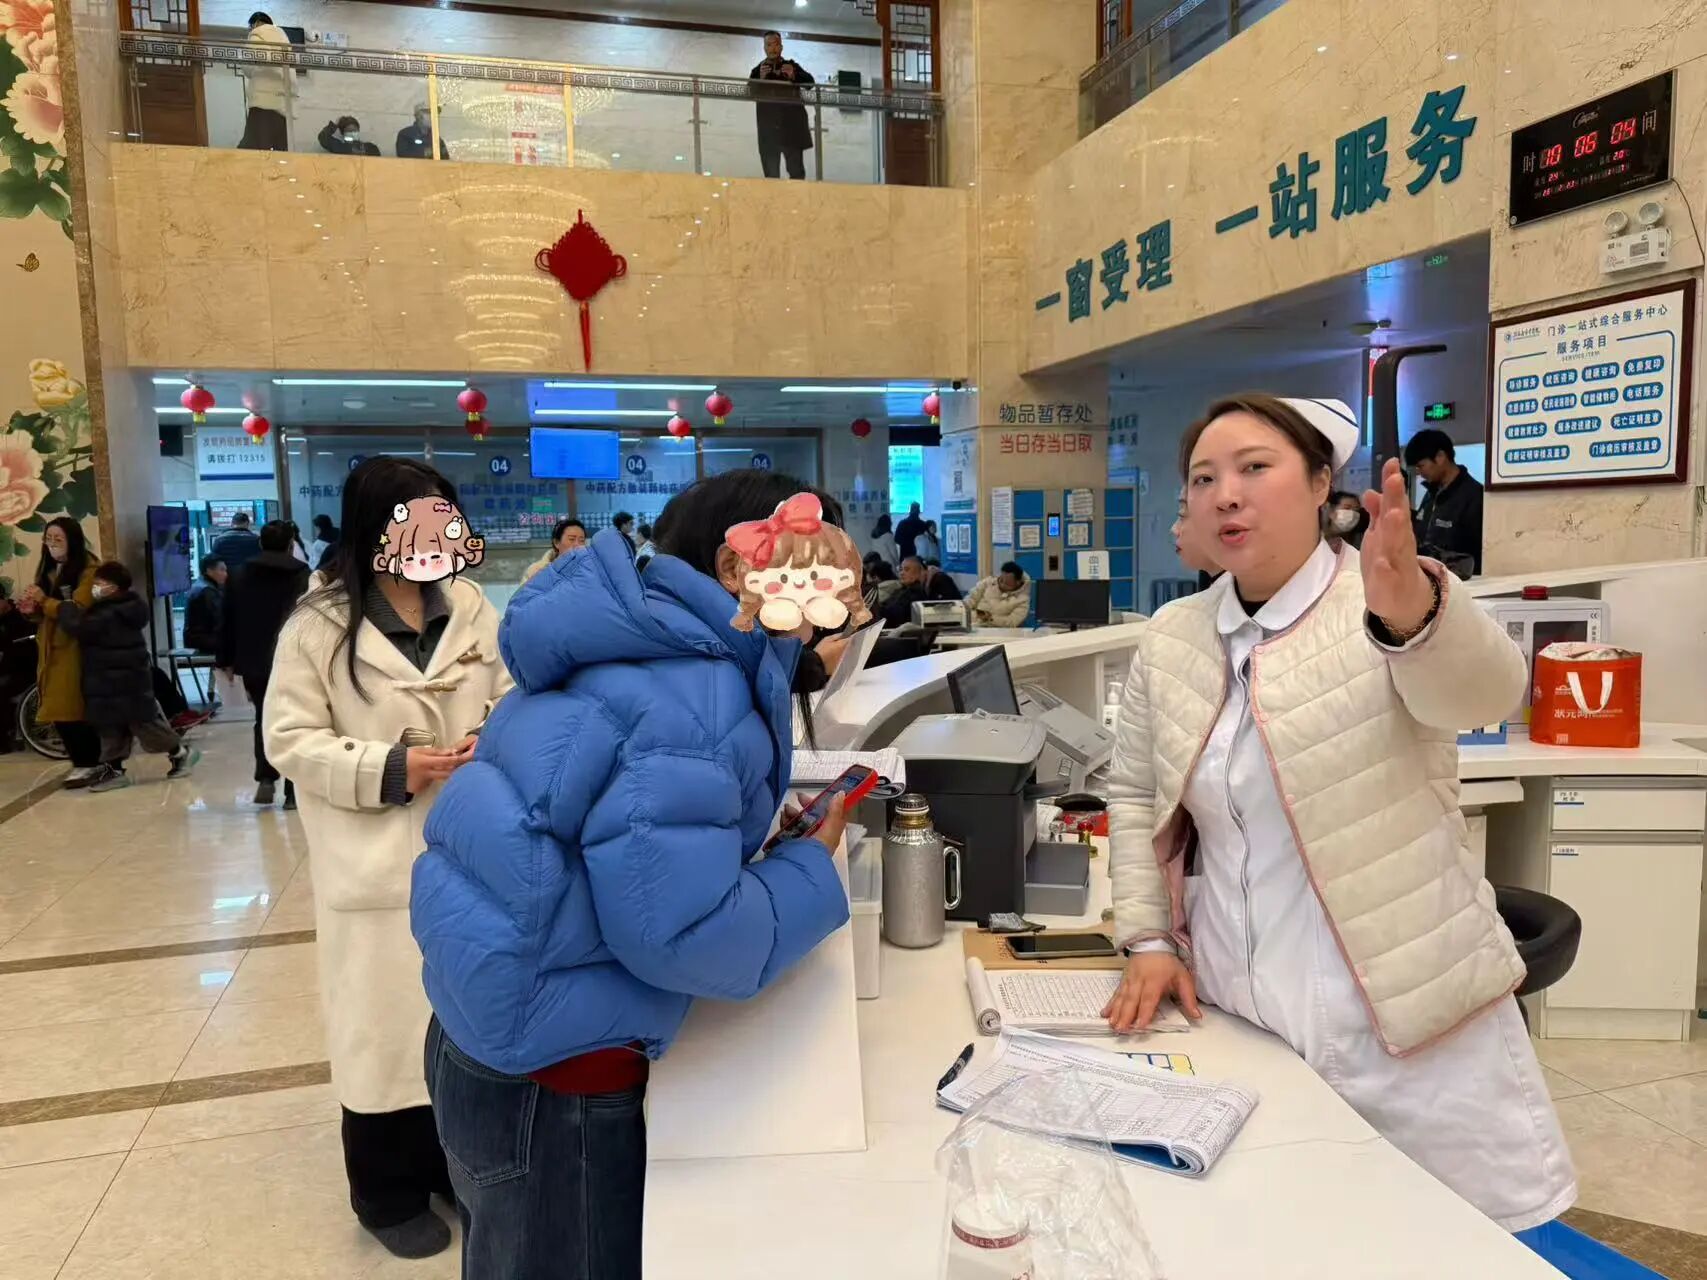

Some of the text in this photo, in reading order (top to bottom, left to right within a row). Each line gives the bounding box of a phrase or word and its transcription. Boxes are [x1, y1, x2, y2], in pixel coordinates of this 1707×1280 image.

[1642, 109, 1657, 135] 间
[1523, 152, 1536, 173] 时
[1035, 85, 1478, 323] 一窗受理 一站服务
[1547, 303, 1668, 337] 门诊一站式综合服务中心
[1556, 335, 1607, 354] 服务项目
[1627, 385, 1660, 398] 电话服务
[1000, 403, 1093, 424] 物品暂存处
[1000, 433, 1093, 454] 当日存当日取
[239, 454, 266, 463] 12315
[491, 459, 508, 473] 04
[627, 458, 644, 470] 04
